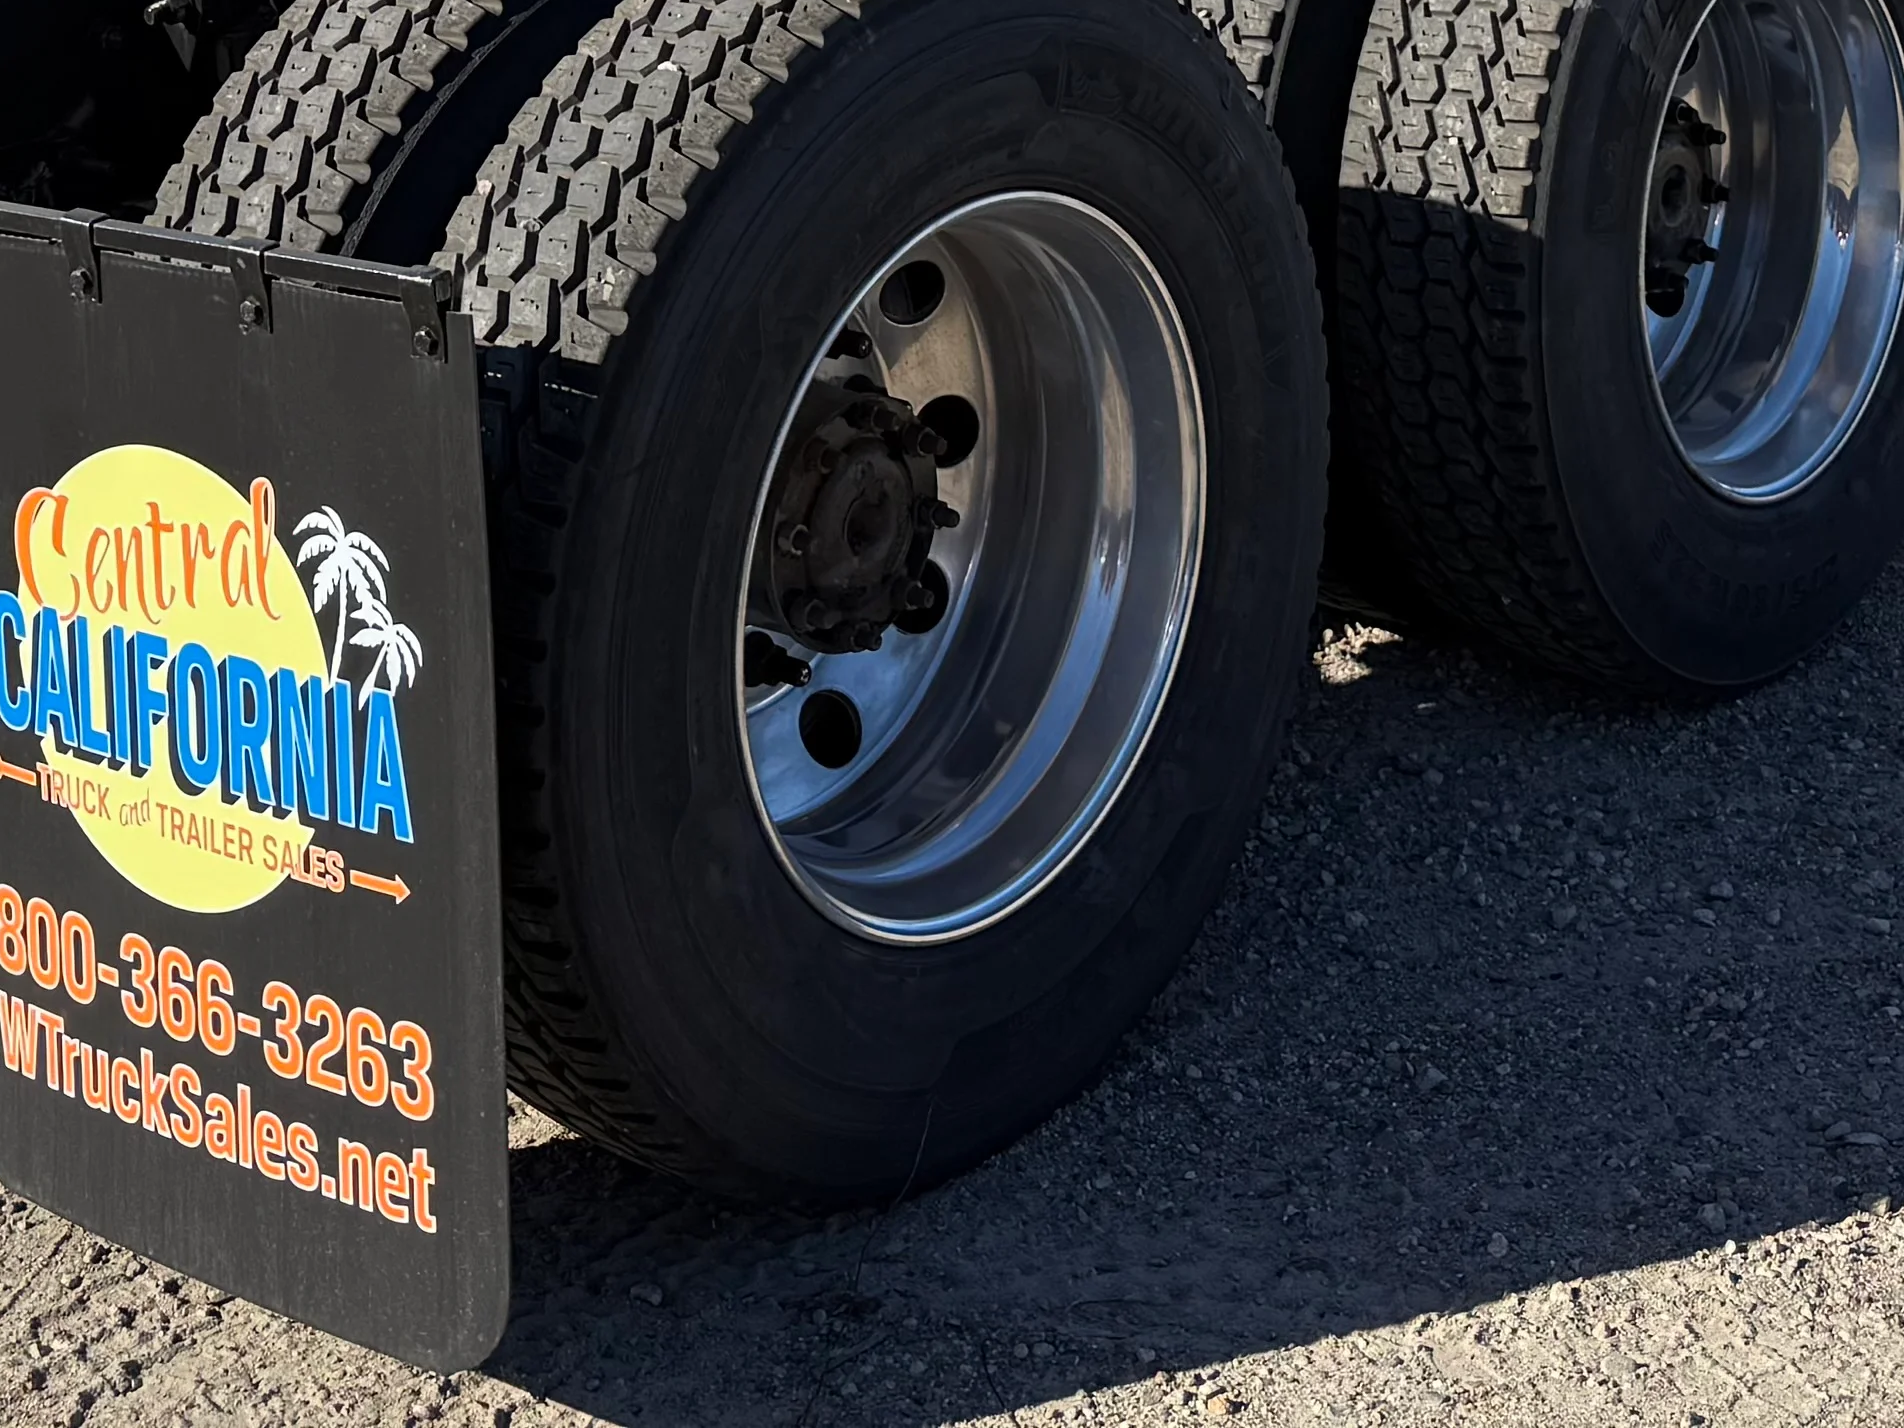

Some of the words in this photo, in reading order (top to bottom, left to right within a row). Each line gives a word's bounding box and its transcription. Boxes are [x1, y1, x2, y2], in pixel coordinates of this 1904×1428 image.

[15, 477, 280, 622] Central
[36, 762, 111, 821] TRUCK
[119, 788, 152, 827] and
[156, 802, 255, 865] TRAILER
[262, 834, 345, 893] SALES
